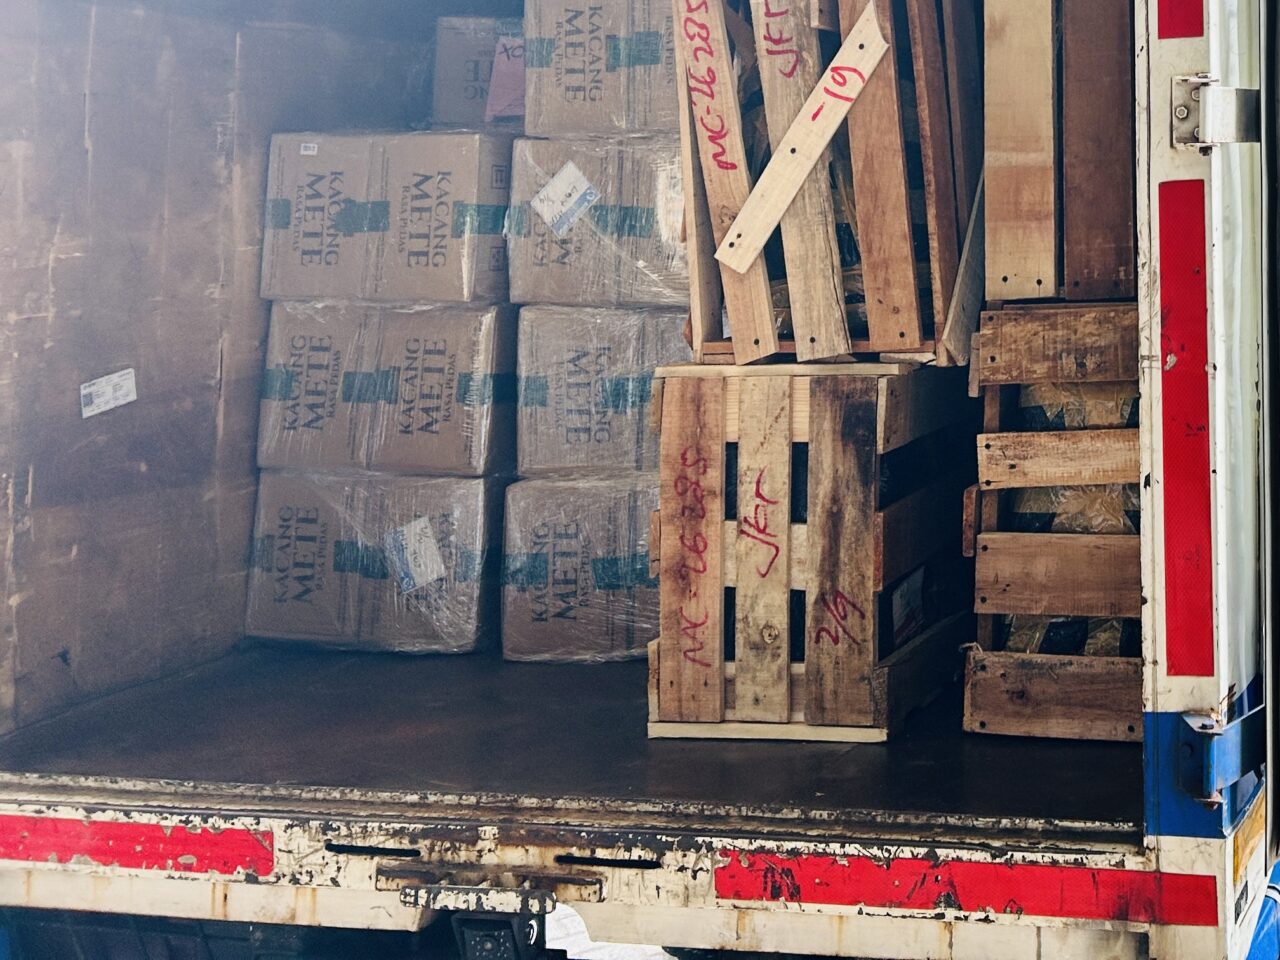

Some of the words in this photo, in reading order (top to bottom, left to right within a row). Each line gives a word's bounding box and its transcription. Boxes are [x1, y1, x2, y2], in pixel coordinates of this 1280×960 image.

[565, 7, 586, 104] METE
[588, 6, 603, 103] KACANG
[301, 172, 327, 267] METE
[325, 171, 345, 266] KACANG
[407, 172, 433, 268] METE
[432, 171, 452, 268] KACANG
[302, 335, 332, 431] METE
[400, 338, 421, 435] KACANG
[417, 339, 447, 435] METE
[566, 348, 592, 443] METE
[273, 506, 293, 603] KACANG
[291, 507, 319, 603] METE
[552, 519, 579, 620] METE
